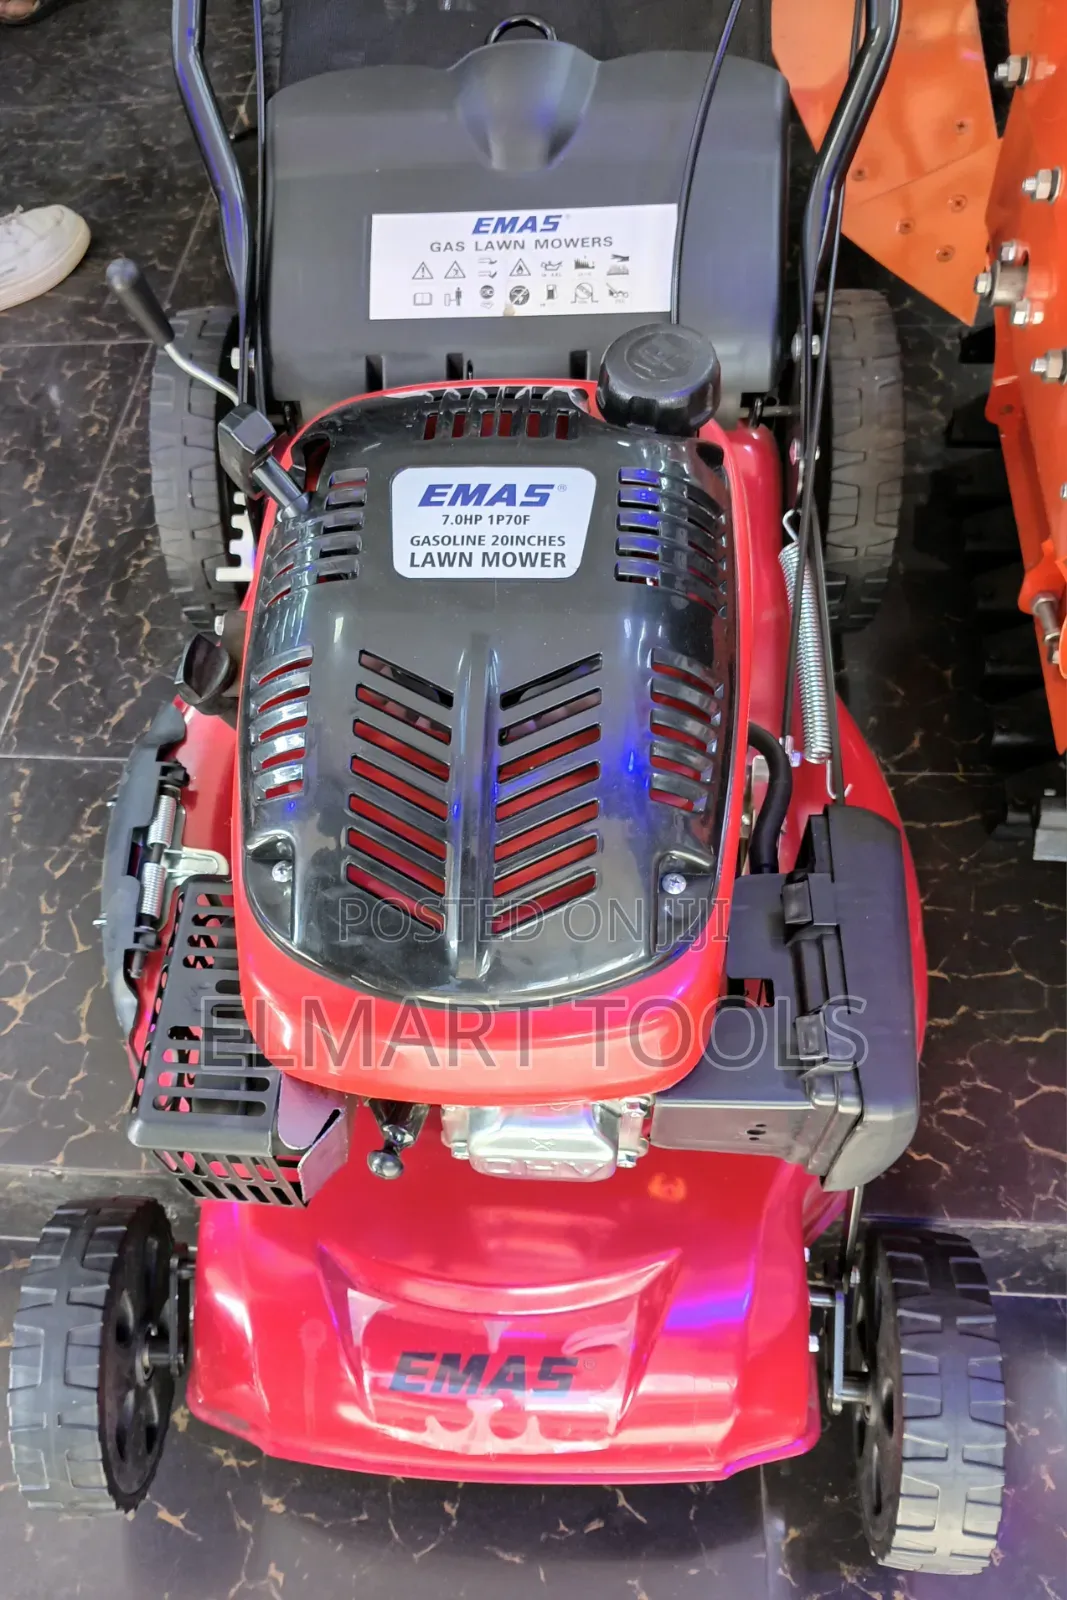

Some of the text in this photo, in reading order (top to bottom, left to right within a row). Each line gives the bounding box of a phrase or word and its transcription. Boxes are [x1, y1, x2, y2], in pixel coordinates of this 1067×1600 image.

[471, 214, 563, 235] EMAS
[430, 236, 614, 253] GAS LAWN MOWERS
[417, 483, 555, 508] EMAS
[442, 514, 531, 526] 7.0HP 1P70F
[410, 535, 566, 547] GASOLINE 20INCHES
[409, 551, 567, 568] LAWN MOWER
[389, 1351, 578, 1397] EMAS
